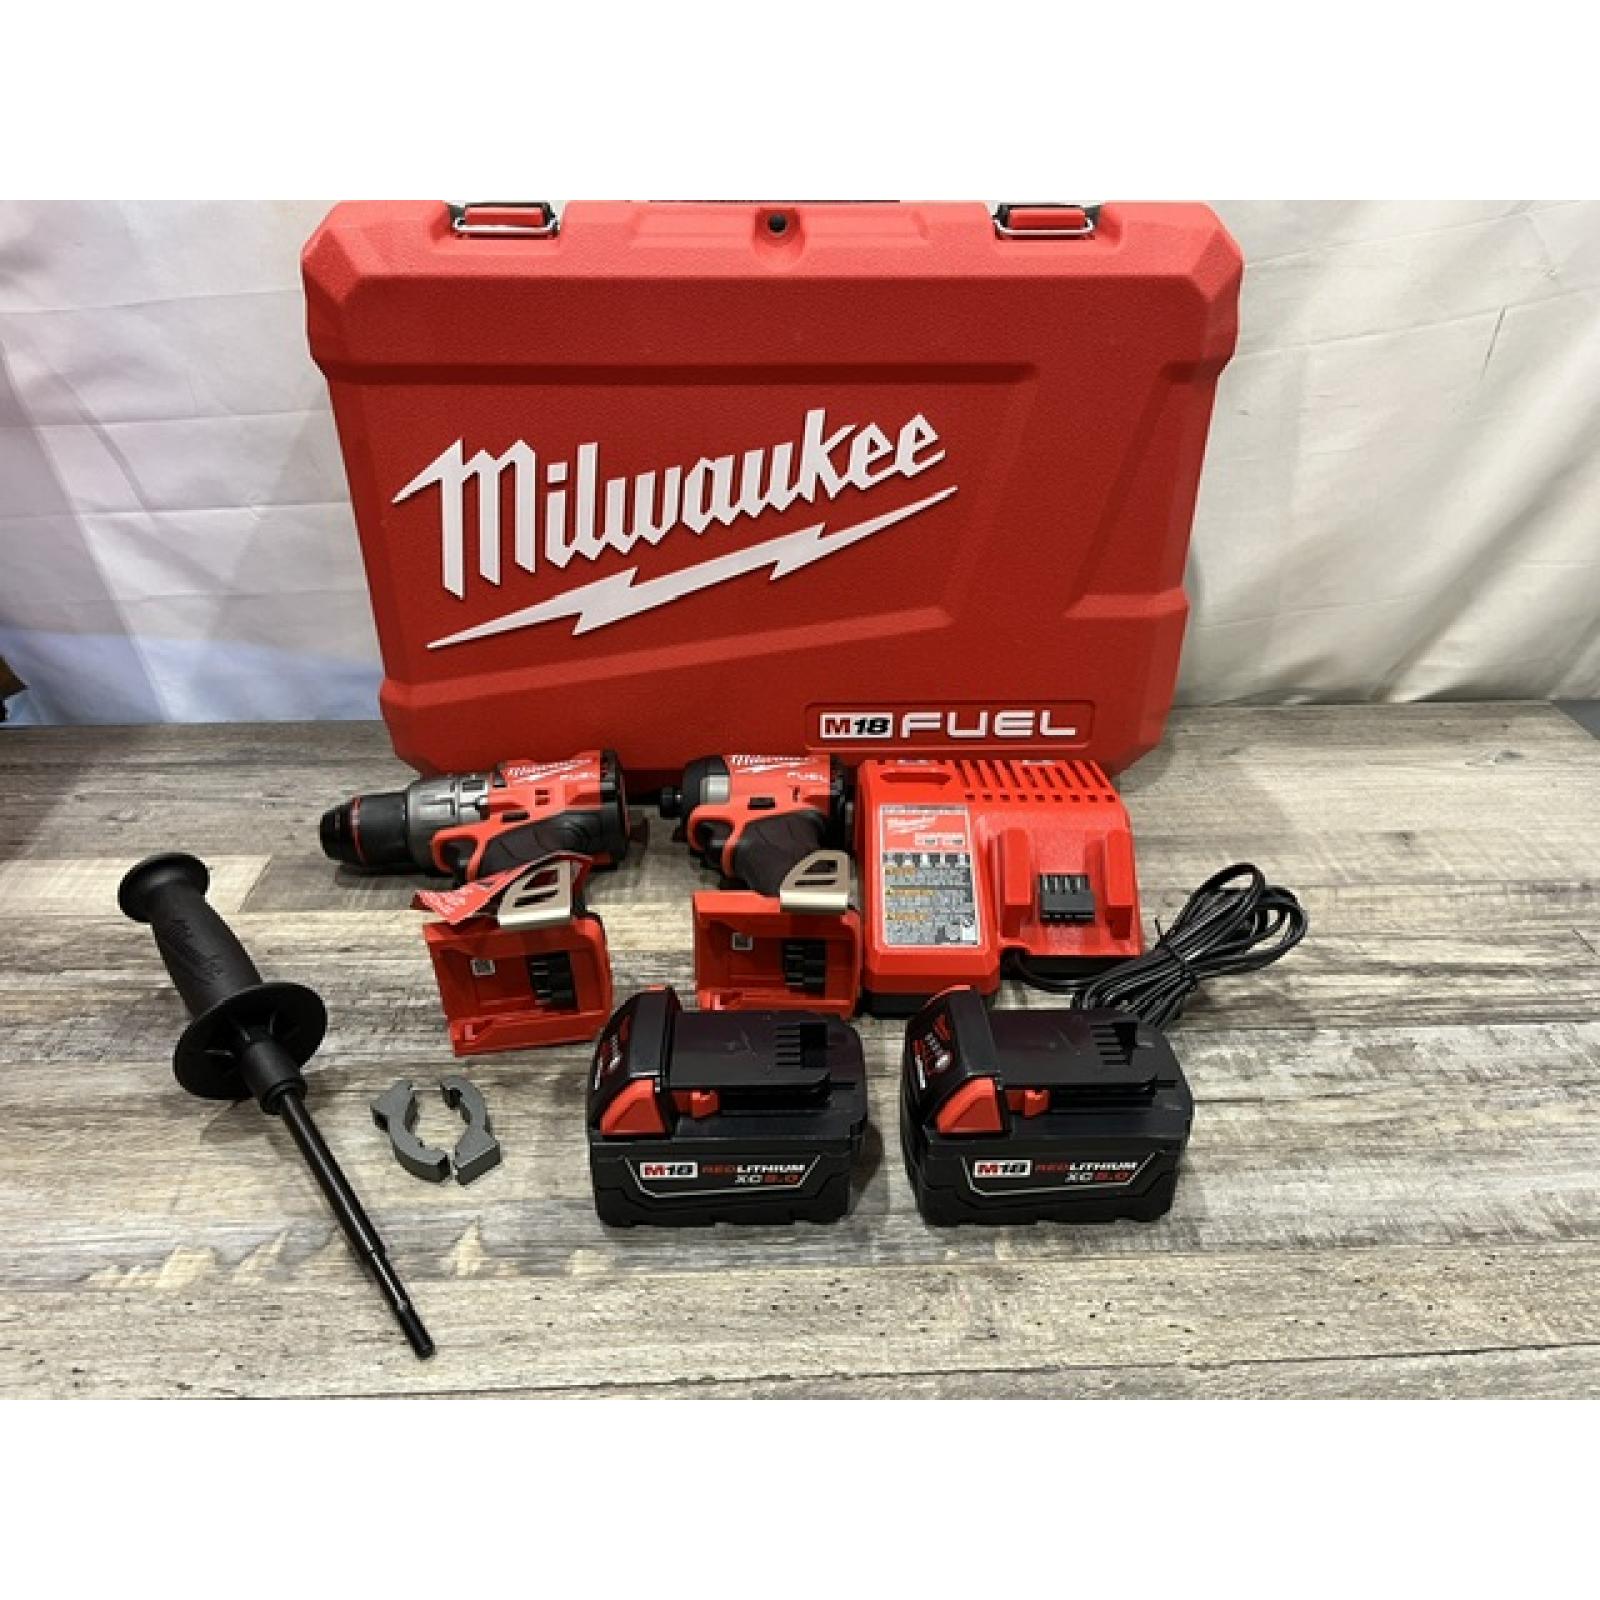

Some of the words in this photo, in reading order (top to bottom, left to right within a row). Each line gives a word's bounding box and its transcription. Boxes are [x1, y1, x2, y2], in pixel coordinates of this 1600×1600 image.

[392, 408, 946, 600] Milwaukee
[823, 717, 891, 736] M18
[901, 709, 1077, 738] FUEL
[644, 1164, 694, 1177] M18
[976, 1162, 1027, 1175] M18
